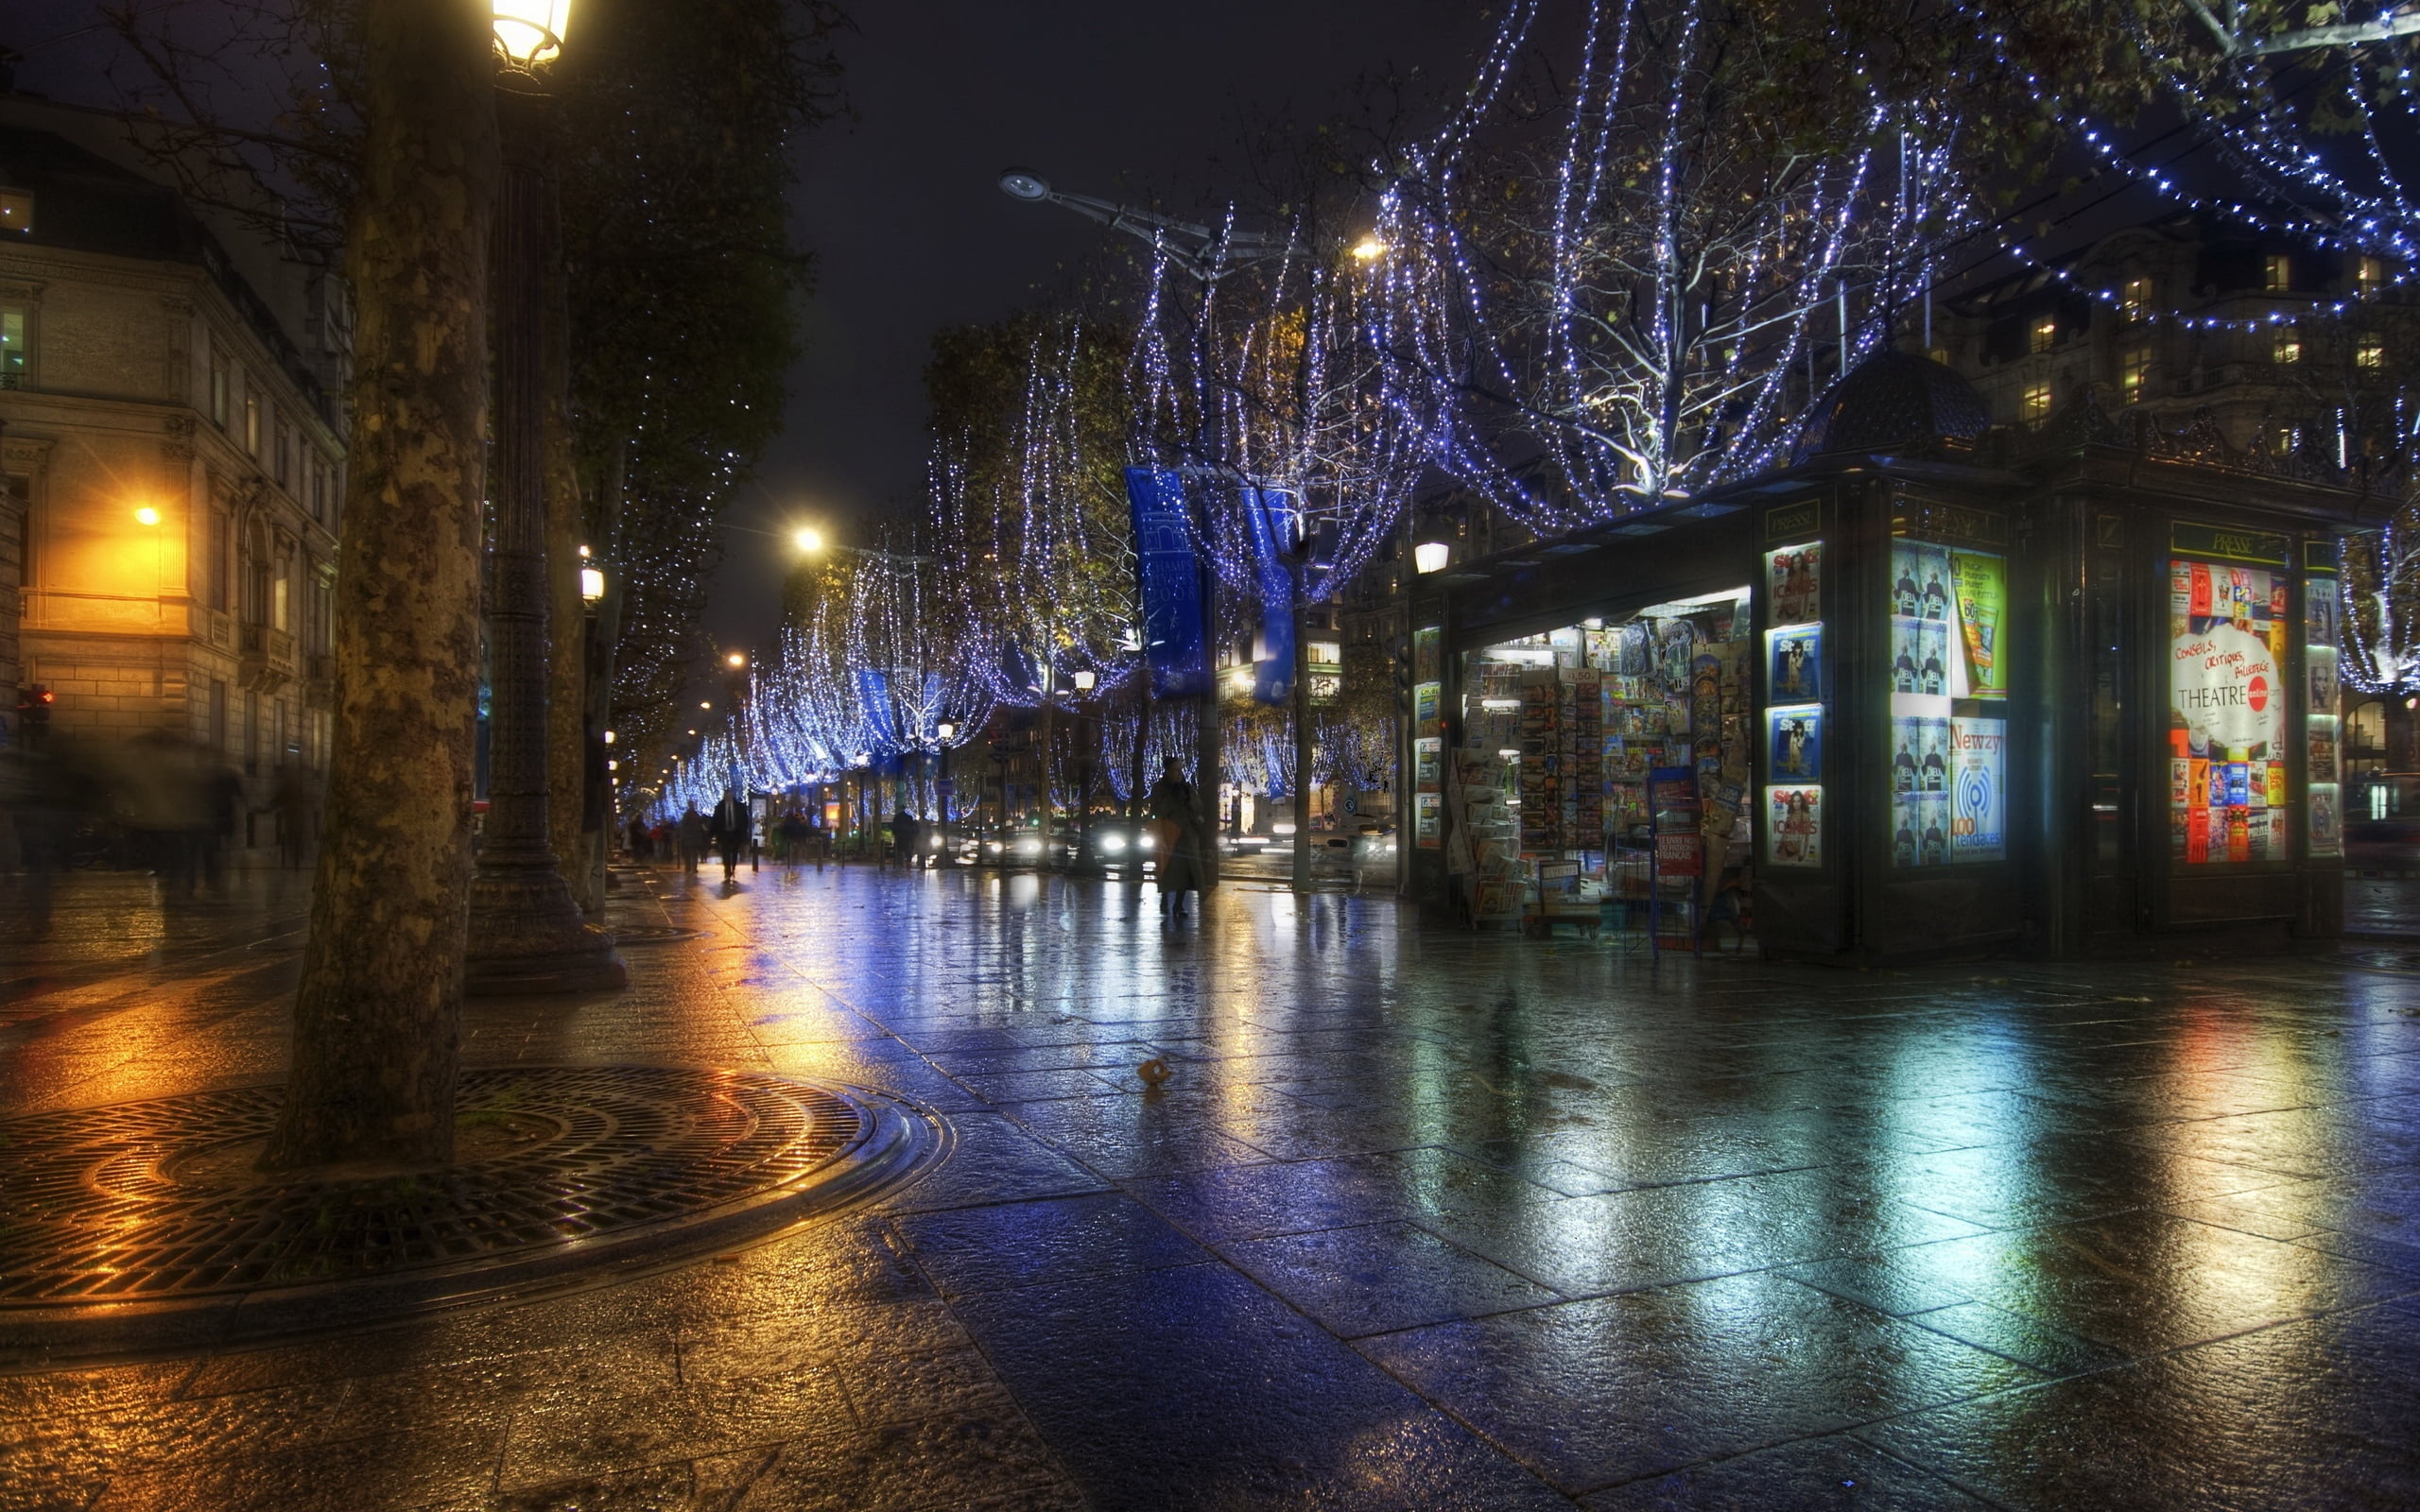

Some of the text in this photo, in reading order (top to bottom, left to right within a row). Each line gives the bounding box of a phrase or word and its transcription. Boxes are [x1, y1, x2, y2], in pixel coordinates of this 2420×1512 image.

[2213, 533, 2254, 556] PRESSE
[1773, 548, 1819, 569] Stff
[1779, 639, 1816, 653] Stff
[2178, 685, 2247, 709] THEATRE
[1779, 718, 1817, 732] Stff
[1949, 724, 2001, 755] Newzy
[1773, 789, 1820, 805] Stff
